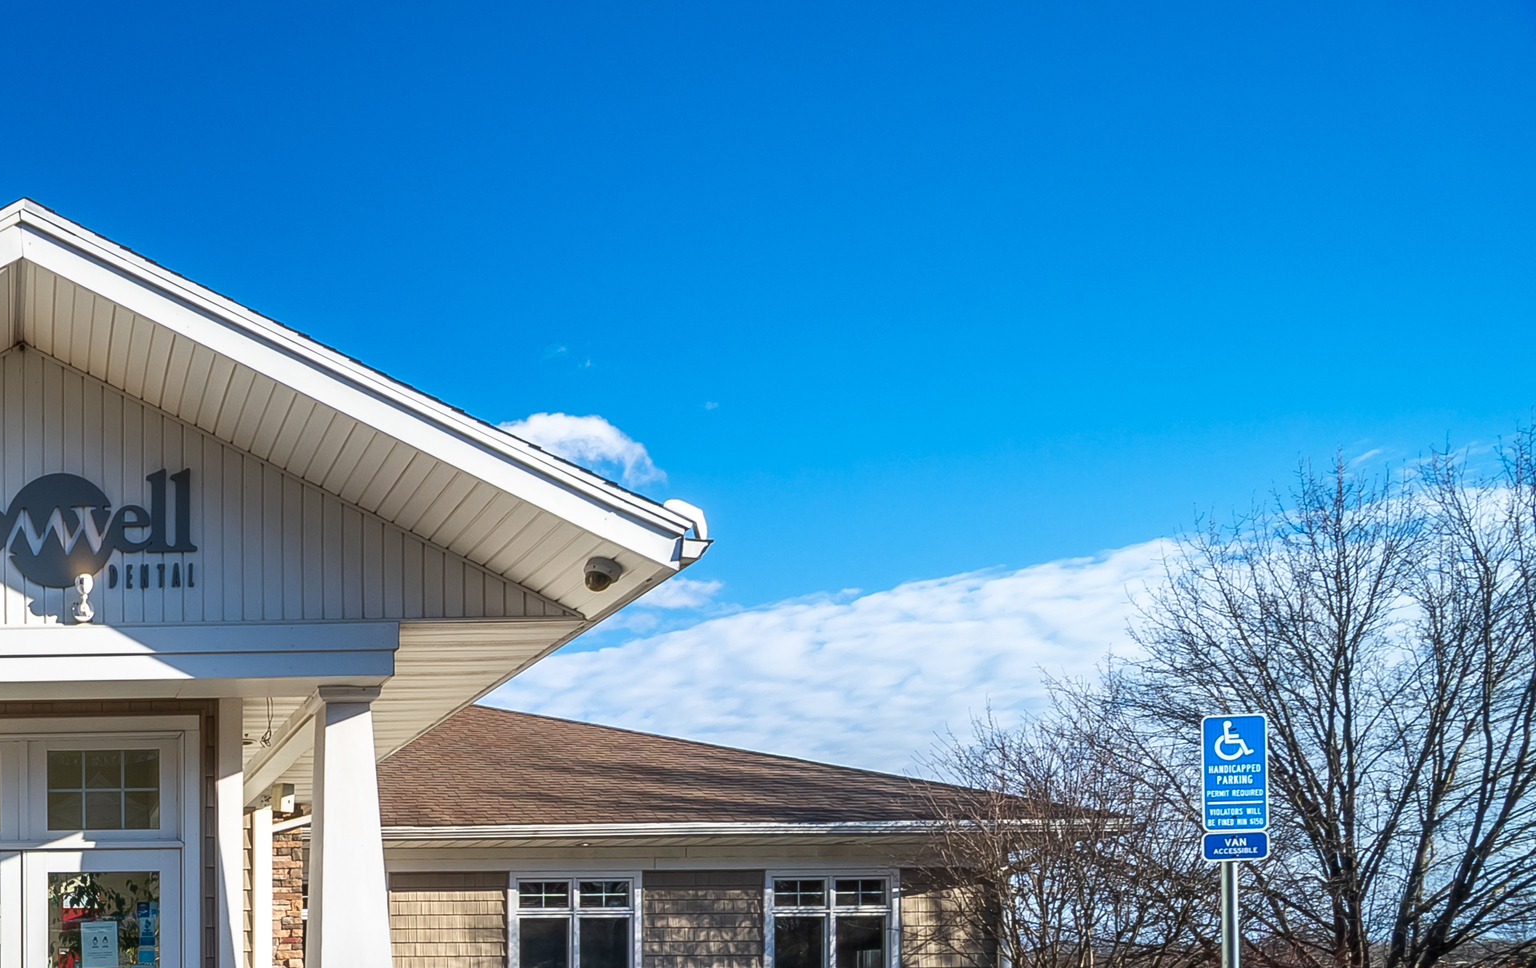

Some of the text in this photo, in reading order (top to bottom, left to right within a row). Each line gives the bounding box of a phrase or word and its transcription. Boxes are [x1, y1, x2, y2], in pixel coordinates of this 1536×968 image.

[108, 562, 195, 589] DENTAL
[1208, 764, 1261, 774] HANDICAPPED
[1216, 775, 1253, 785] PARKING
[1209, 808, 1243, 816] VIOLATORS
[1207, 818, 1216, 827] BE
[1217, 818, 1235, 826] FINED
[1236, 818, 1248, 826] MIN
[1224, 838, 1247, 847] VAN
[1213, 847, 1259, 855] ACCESSIBLE
